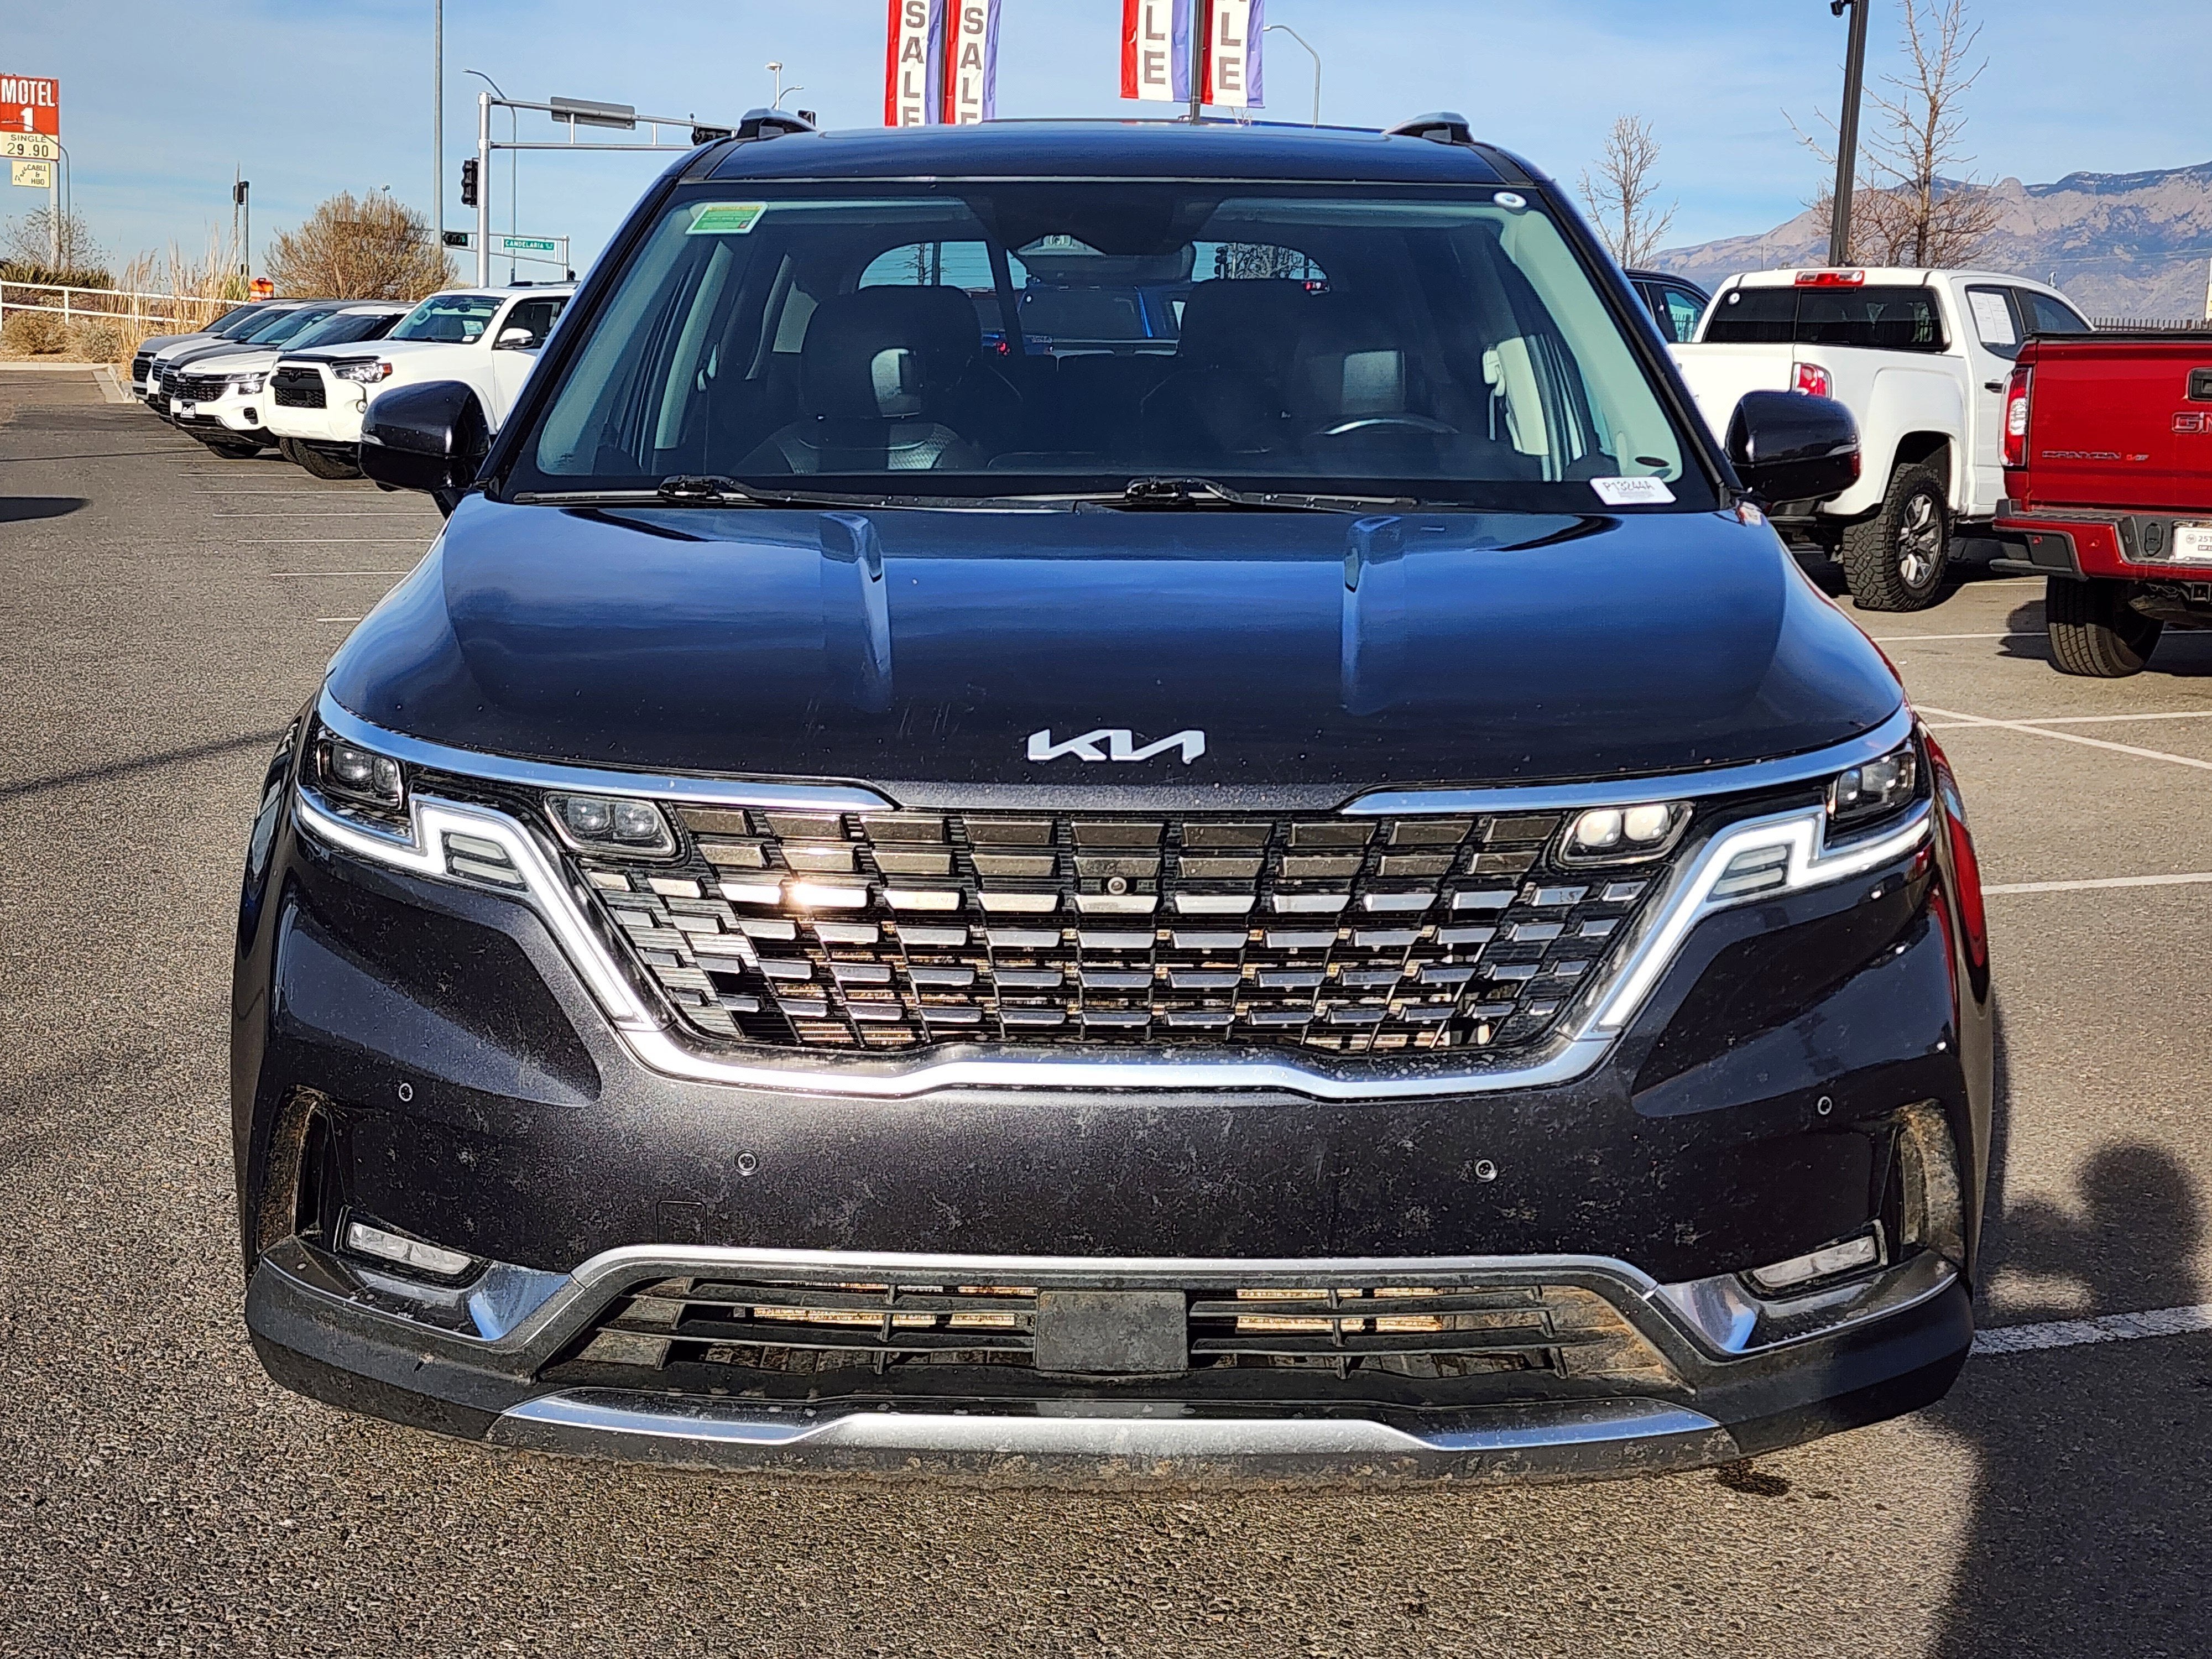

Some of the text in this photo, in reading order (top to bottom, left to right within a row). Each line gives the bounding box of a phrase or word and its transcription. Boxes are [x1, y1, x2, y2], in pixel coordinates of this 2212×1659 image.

[1, 79, 55, 107] MOTEL
[20, 107, 33, 132] 1
[11, 134, 47, 143] SINGLE
[505, 240, 544, 248] CANDELARIA
[2042, 450, 2122, 460] CANYON
[1027, 728, 1206, 765] KIA
